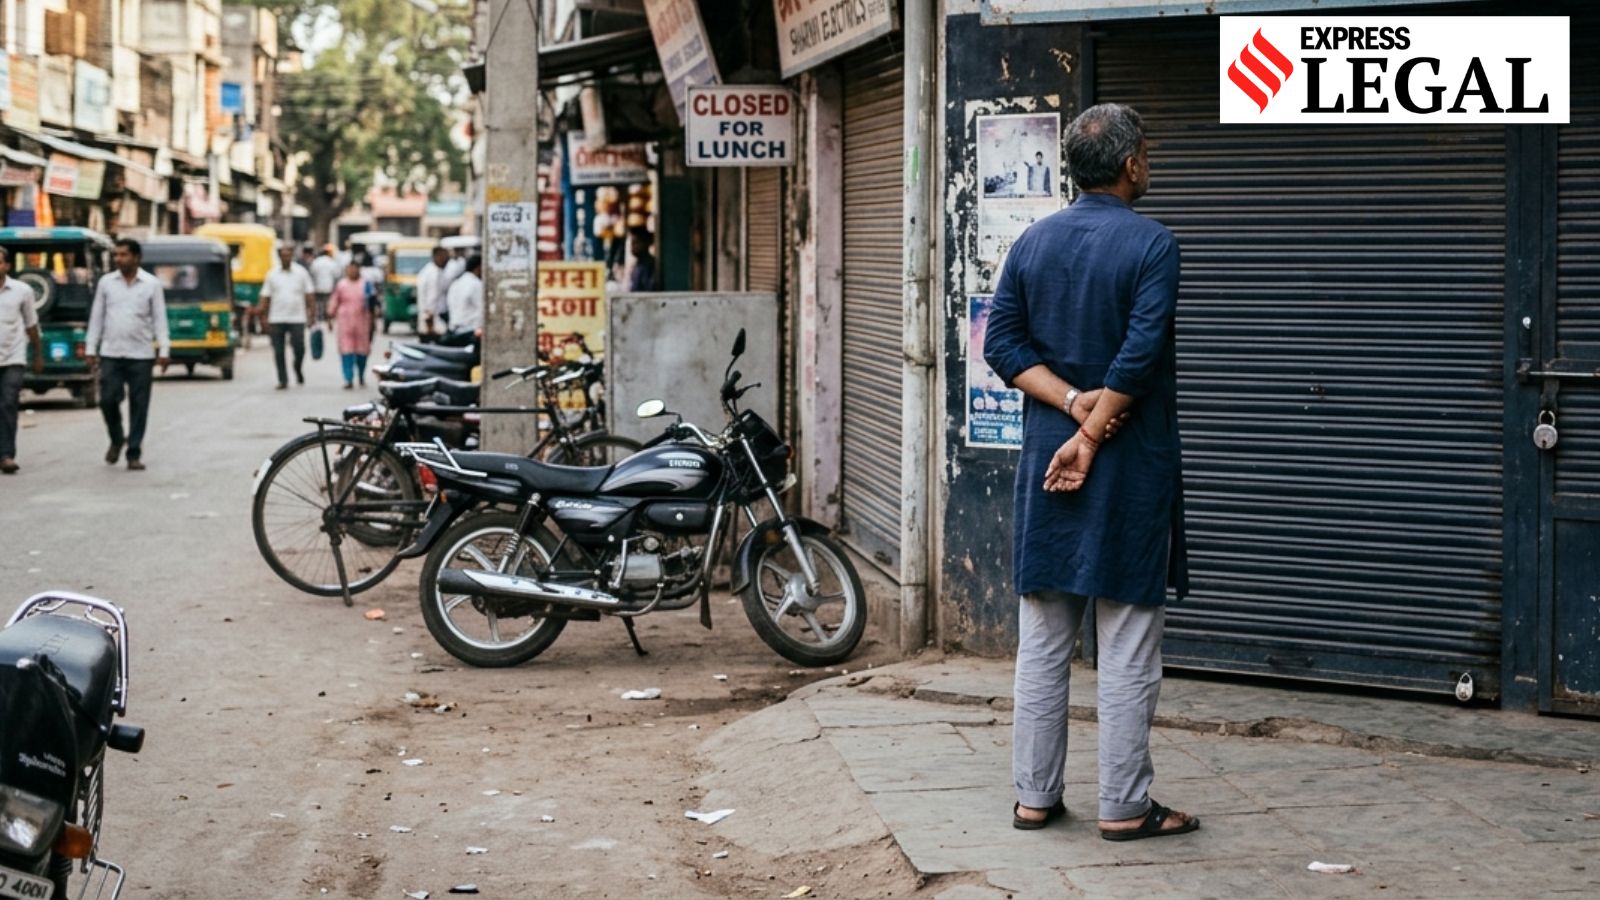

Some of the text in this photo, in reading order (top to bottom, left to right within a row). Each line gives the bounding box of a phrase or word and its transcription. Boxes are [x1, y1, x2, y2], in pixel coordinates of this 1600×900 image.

[693, 94, 789, 116] CLOSED
[720, 121, 763, 136] FOR
[698, 141, 785, 158] LUNCH
